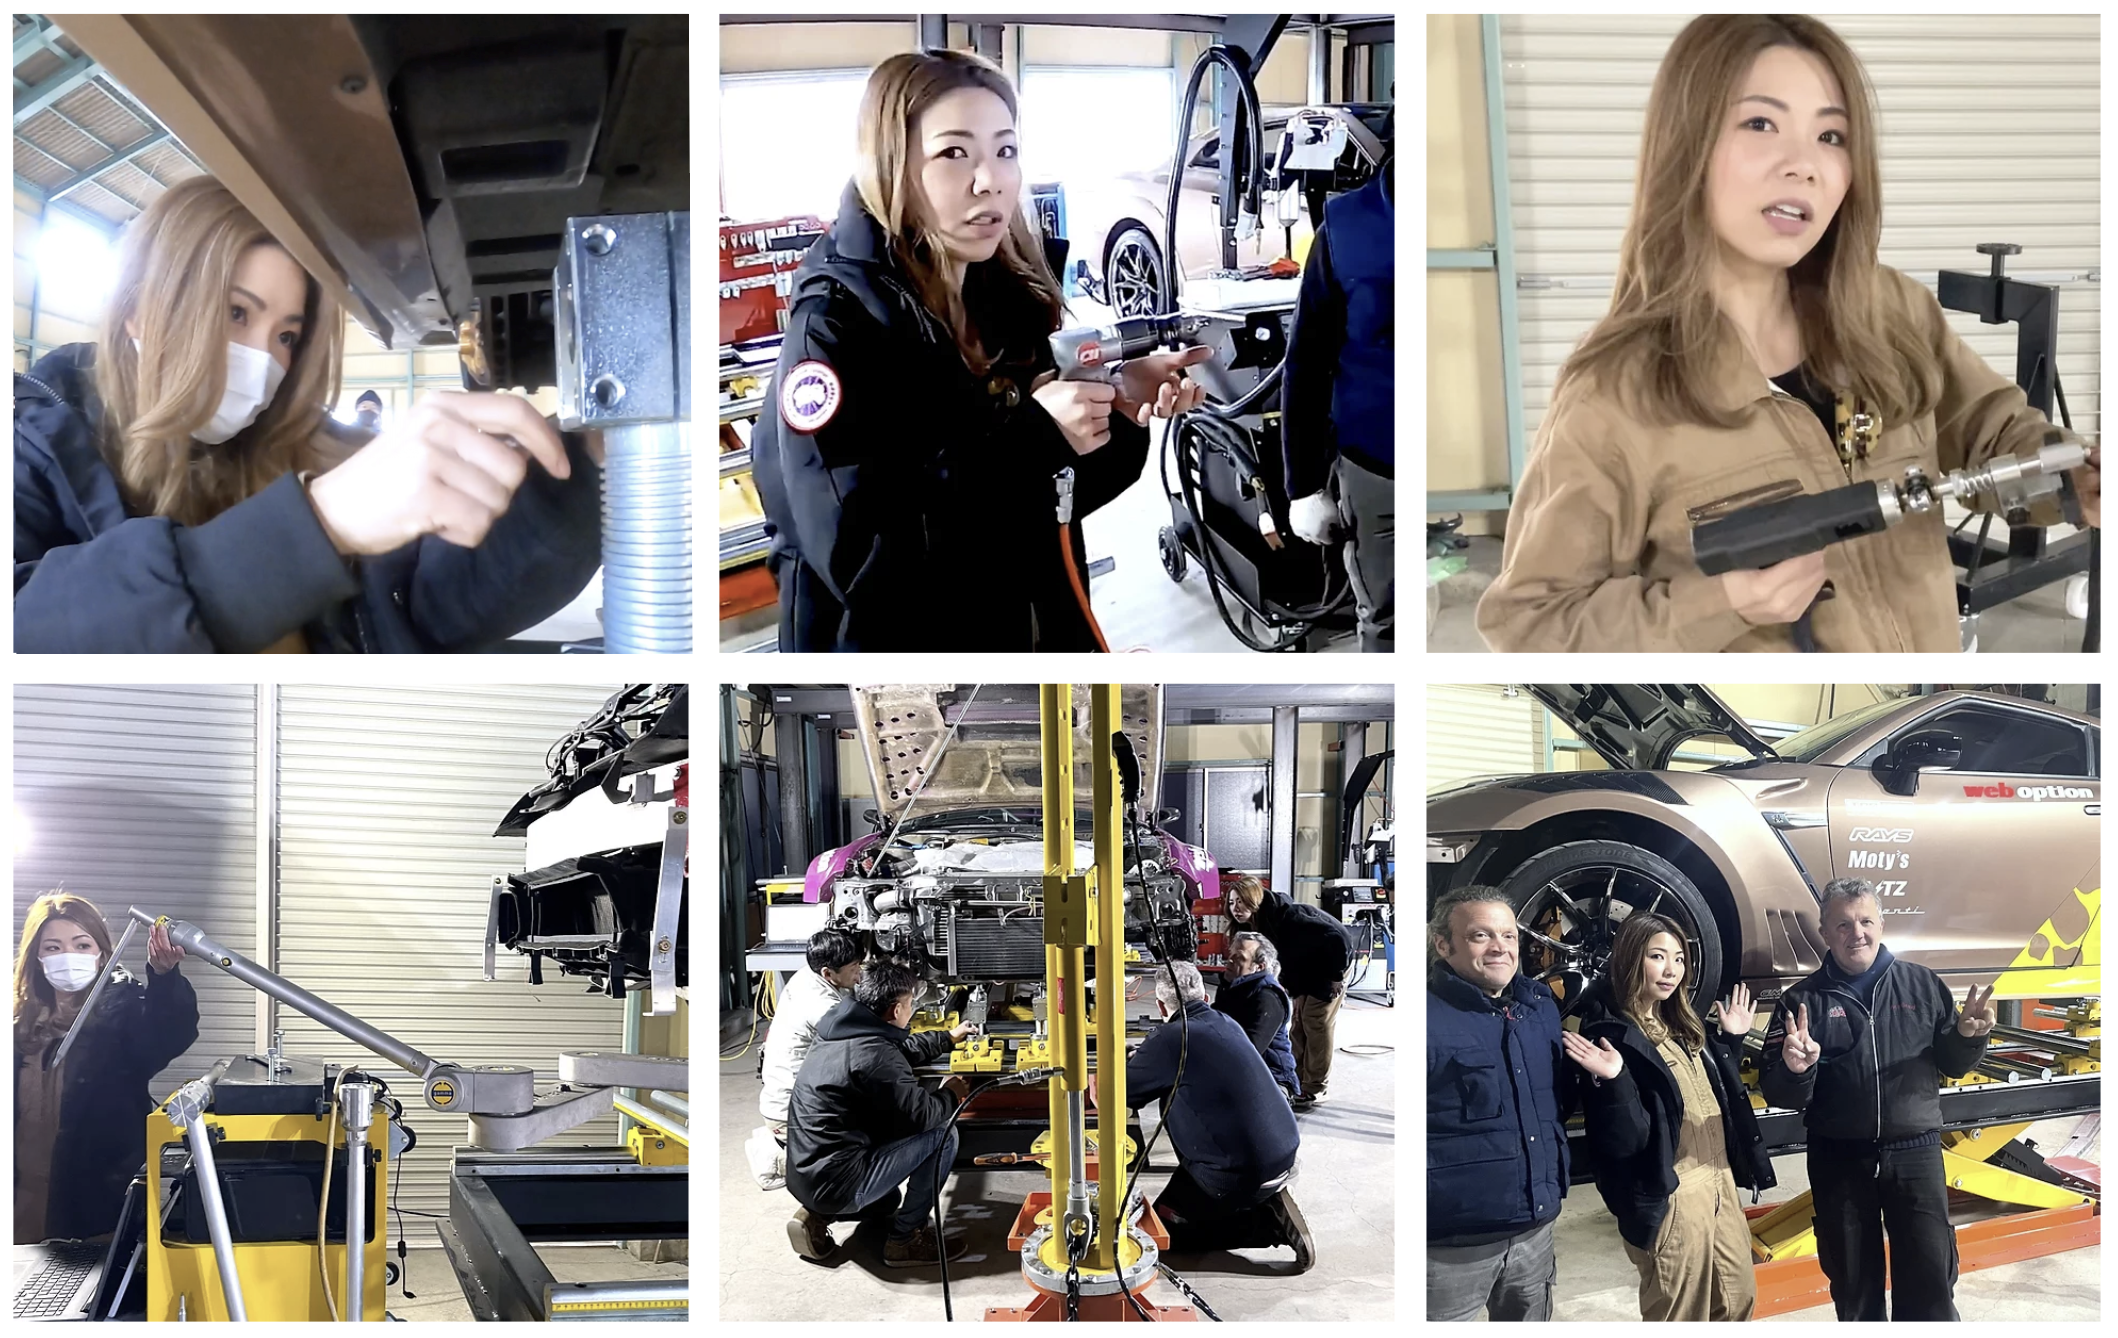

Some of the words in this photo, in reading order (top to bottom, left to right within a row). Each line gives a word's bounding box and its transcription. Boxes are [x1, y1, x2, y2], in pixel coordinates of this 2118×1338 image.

[1963, 782, 2015, 798] web
[2016, 785, 2094, 802] option
[1849, 827, 1914, 842] RAYS
[1848, 850, 1910, 871] Moty's
